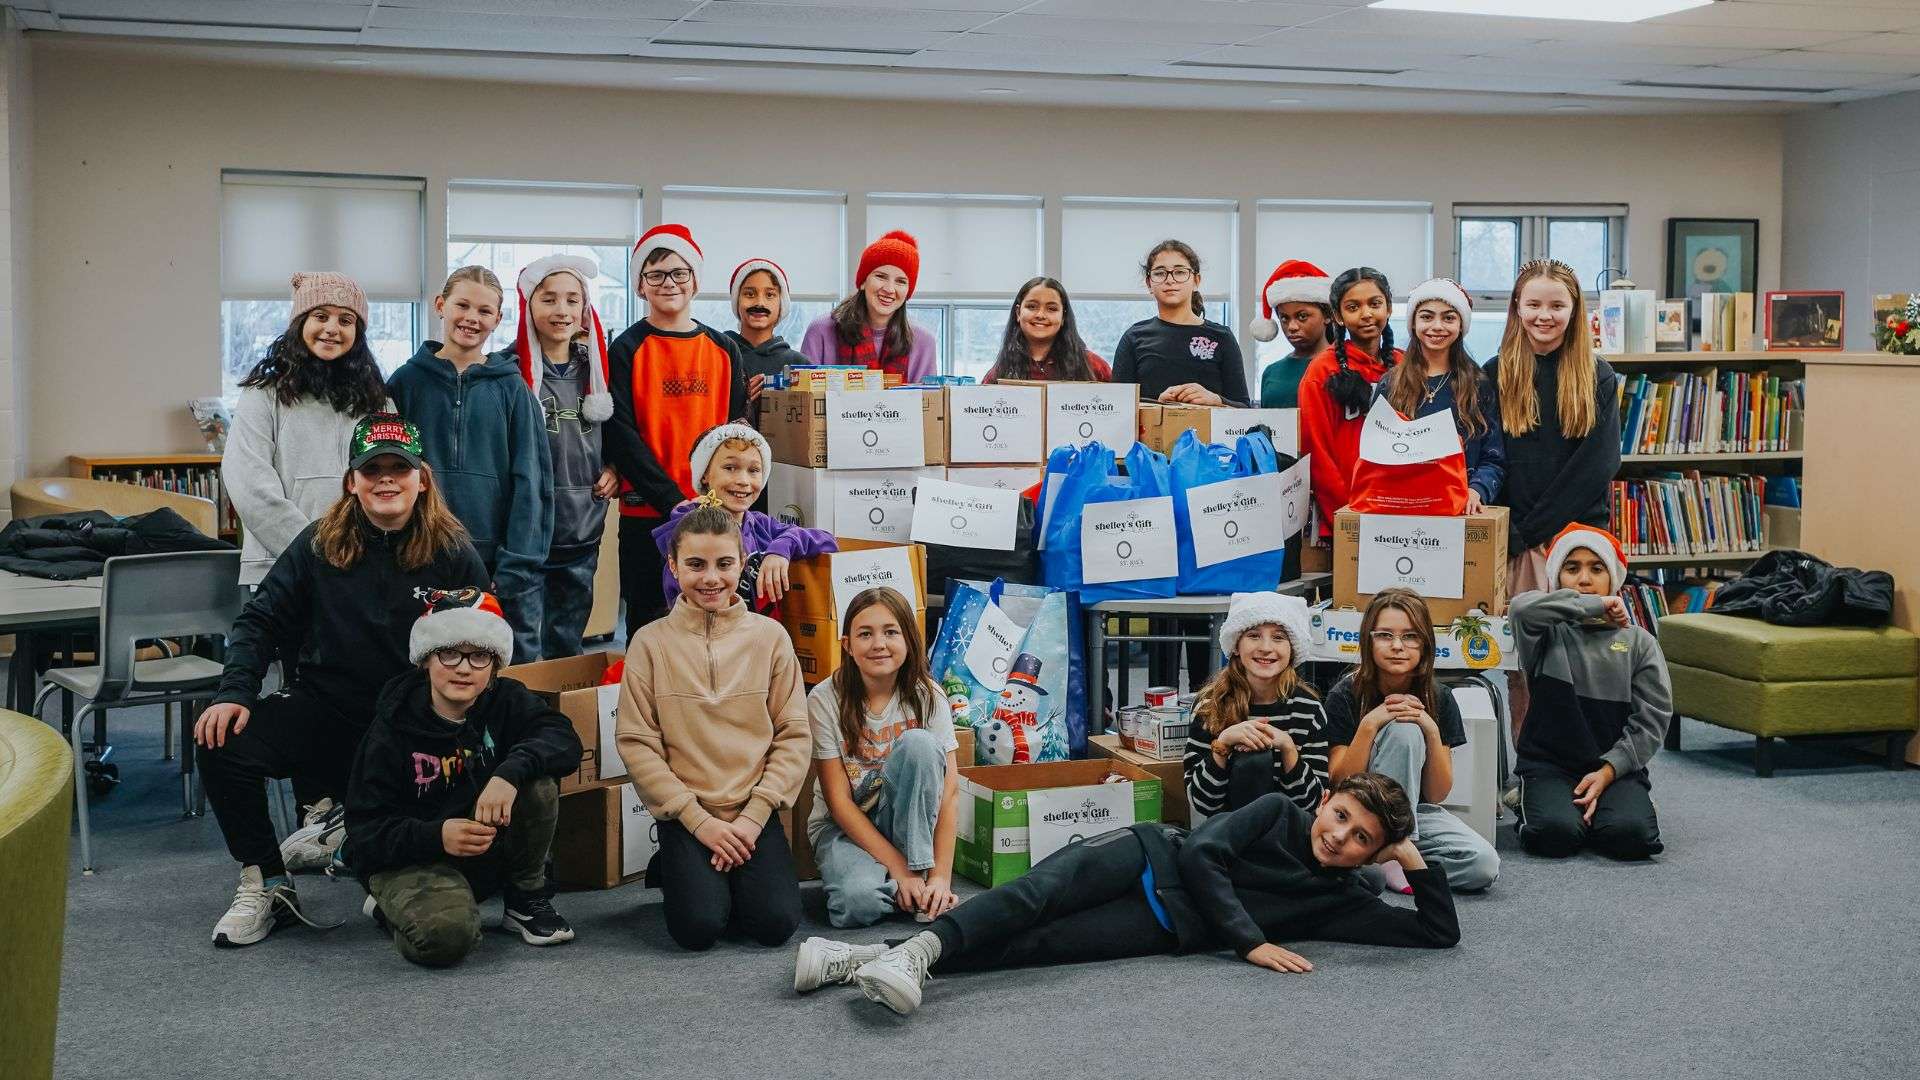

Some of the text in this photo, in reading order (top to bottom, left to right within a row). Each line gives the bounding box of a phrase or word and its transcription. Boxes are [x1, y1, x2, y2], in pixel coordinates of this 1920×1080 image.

[1002, 406, 1018, 415] Gift
[1098, 403, 1114, 412] Gift
[882, 409, 900, 419] Gift
[372, 424, 404, 434] MERRY
[366, 432, 411, 444] CHRISTMAS
[889, 488, 907, 496] Gift
[1240, 496, 1257, 506] Gift
[1135, 519, 1152, 528] Gift
[1374, 534, 1440, 547] shelley's Gift
[878, 570, 893, 580] Gift
[987, 624, 1013, 652] shelley
[1326, 627, 1361, 642] fres
[1043, 809, 1088, 823] shelley's
[1090, 807, 1110, 818] Gift
[1001, 837, 1011, 848] 10
